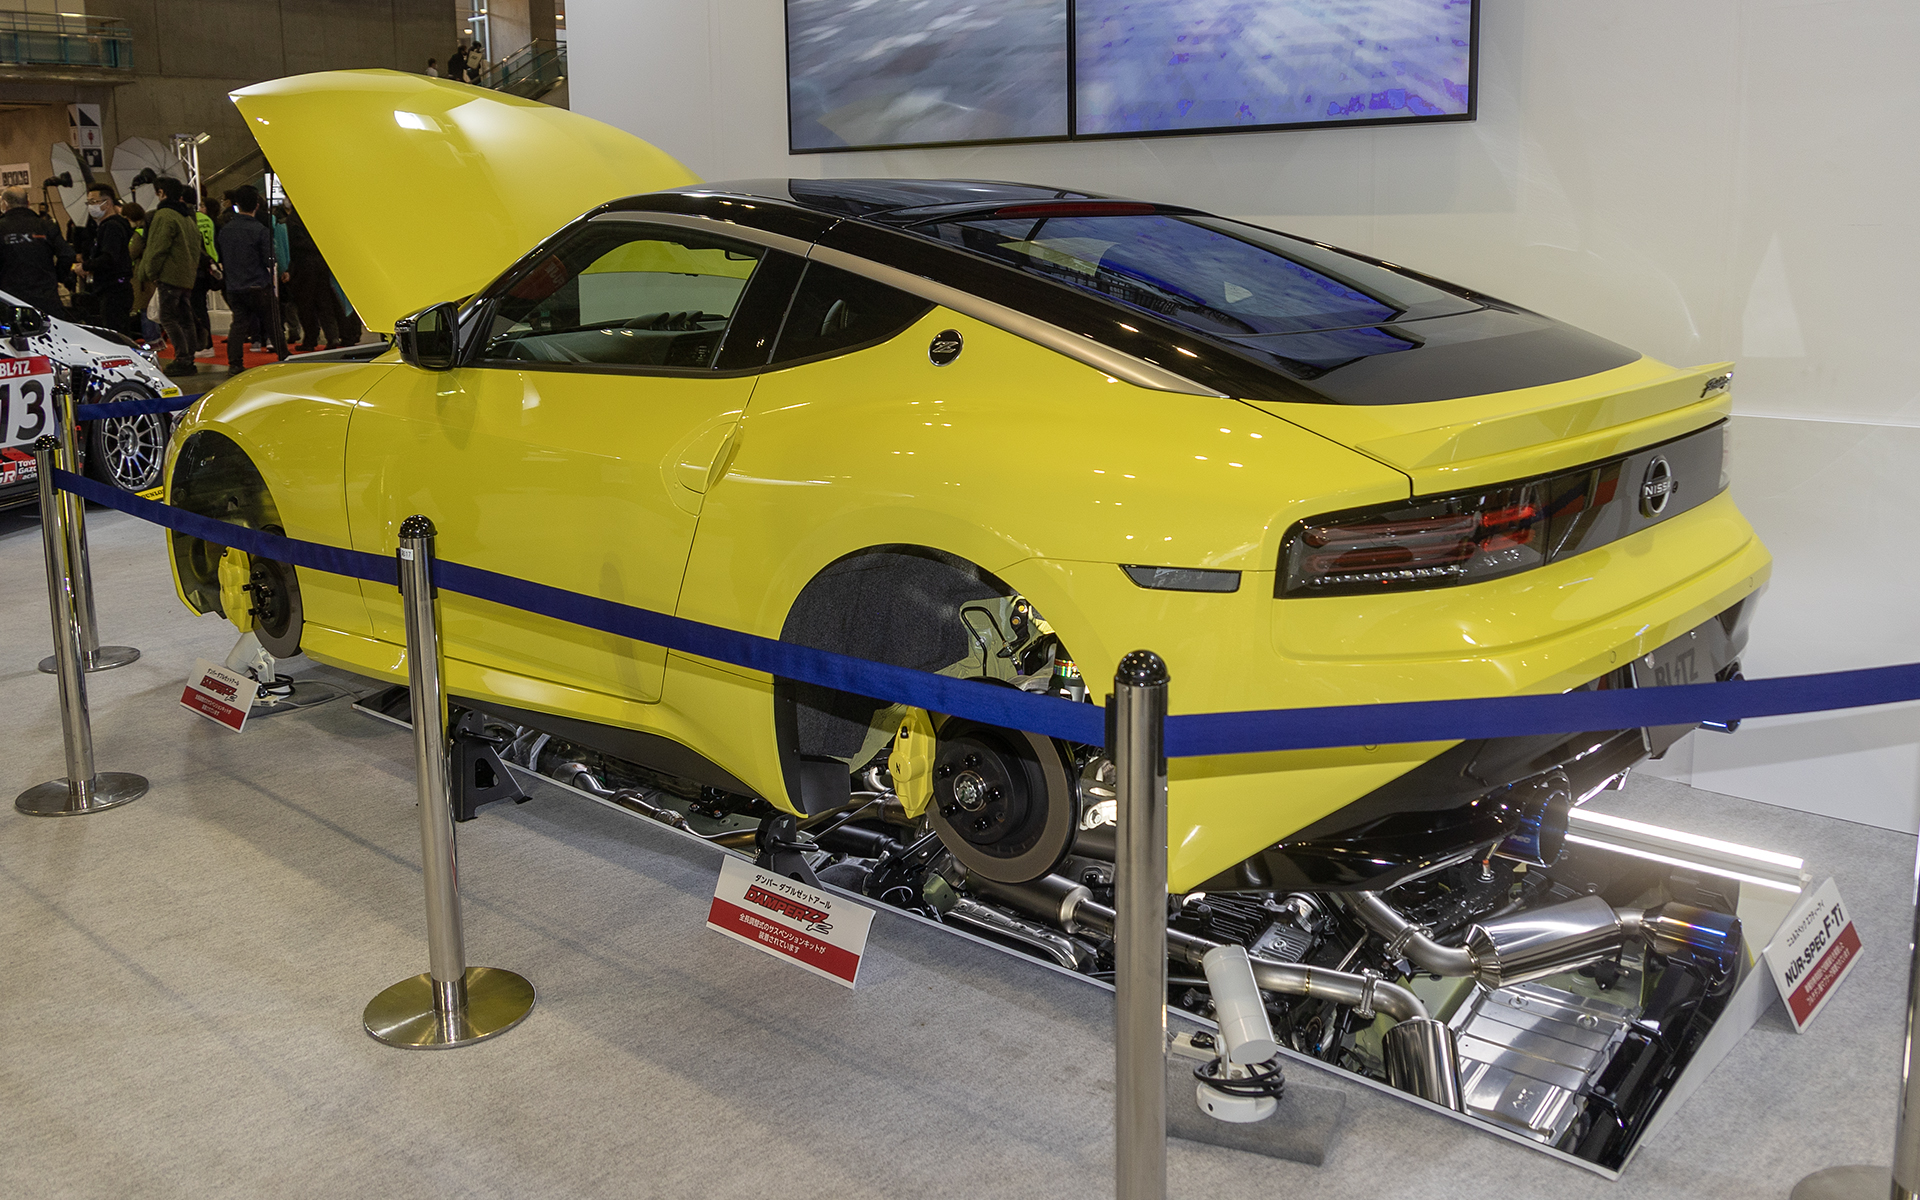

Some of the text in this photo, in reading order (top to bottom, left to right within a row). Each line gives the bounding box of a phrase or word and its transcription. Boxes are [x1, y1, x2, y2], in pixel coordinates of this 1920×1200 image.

[18, 458, 37, 467] TOYO
[18, 466, 37, 475] GAZO
[141, 489, 164, 499] DUNLO
[1645, 481, 1671, 496] NISS
[755, 874, 831, 909] ダンパー ダブルゼットアール
[758, 931, 800, 954] 装着されています
